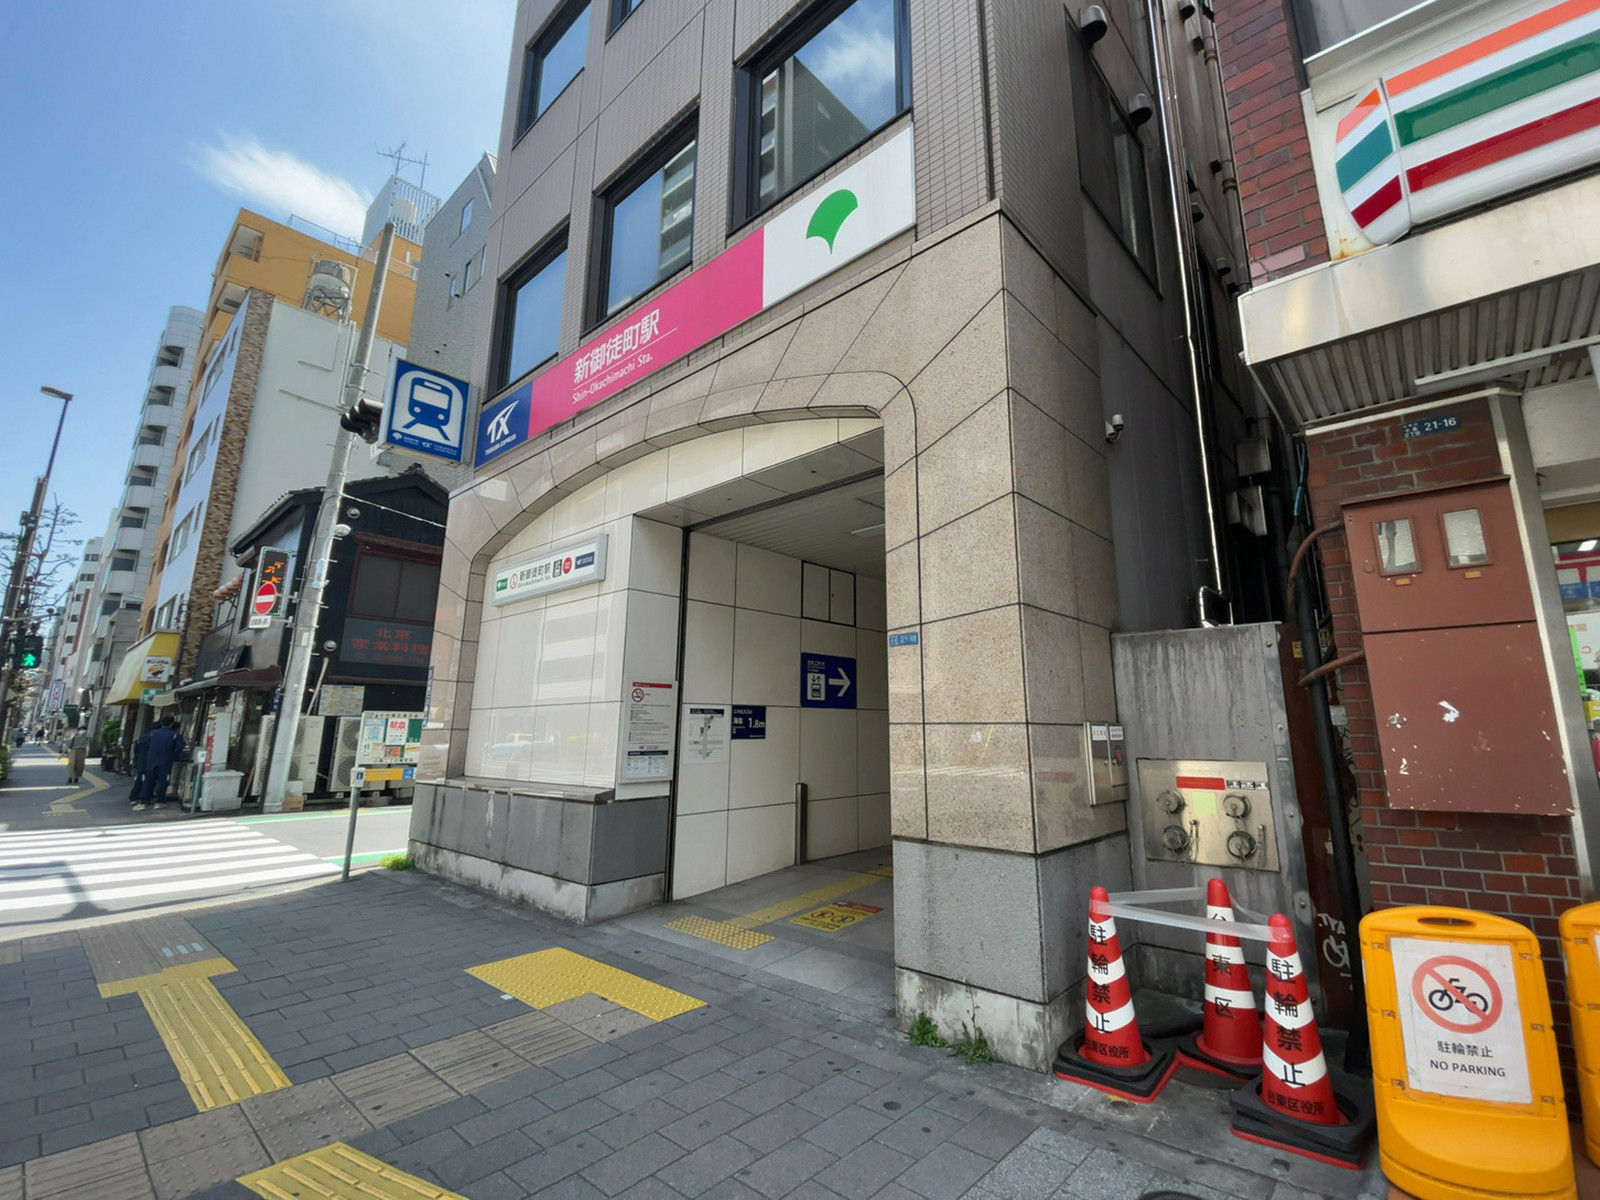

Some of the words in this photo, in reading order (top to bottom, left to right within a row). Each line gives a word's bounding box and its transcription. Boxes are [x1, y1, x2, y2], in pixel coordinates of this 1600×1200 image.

[574, 309, 659, 383] 新御徒町駅
[572, 359, 636, 404] Shin-Okachimachi
[637, 353, 653, 367] Sta.
[487, 400, 519, 443] TX
[1424, 417, 1457, 431] 21-16
[748, 717, 766, 729] 1.8m
[1089, 923, 1112, 1034] 駐輪禁止
[1271, 957, 1306, 1087] 駐輪禁止
[1437, 1041, 1494, 1058] 駐輪禁止
[1430, 1060, 1449, 1071] NO
[1452, 1062, 1506, 1077] PARKING
[1267, 1089, 1325, 1116] 台東区役所
